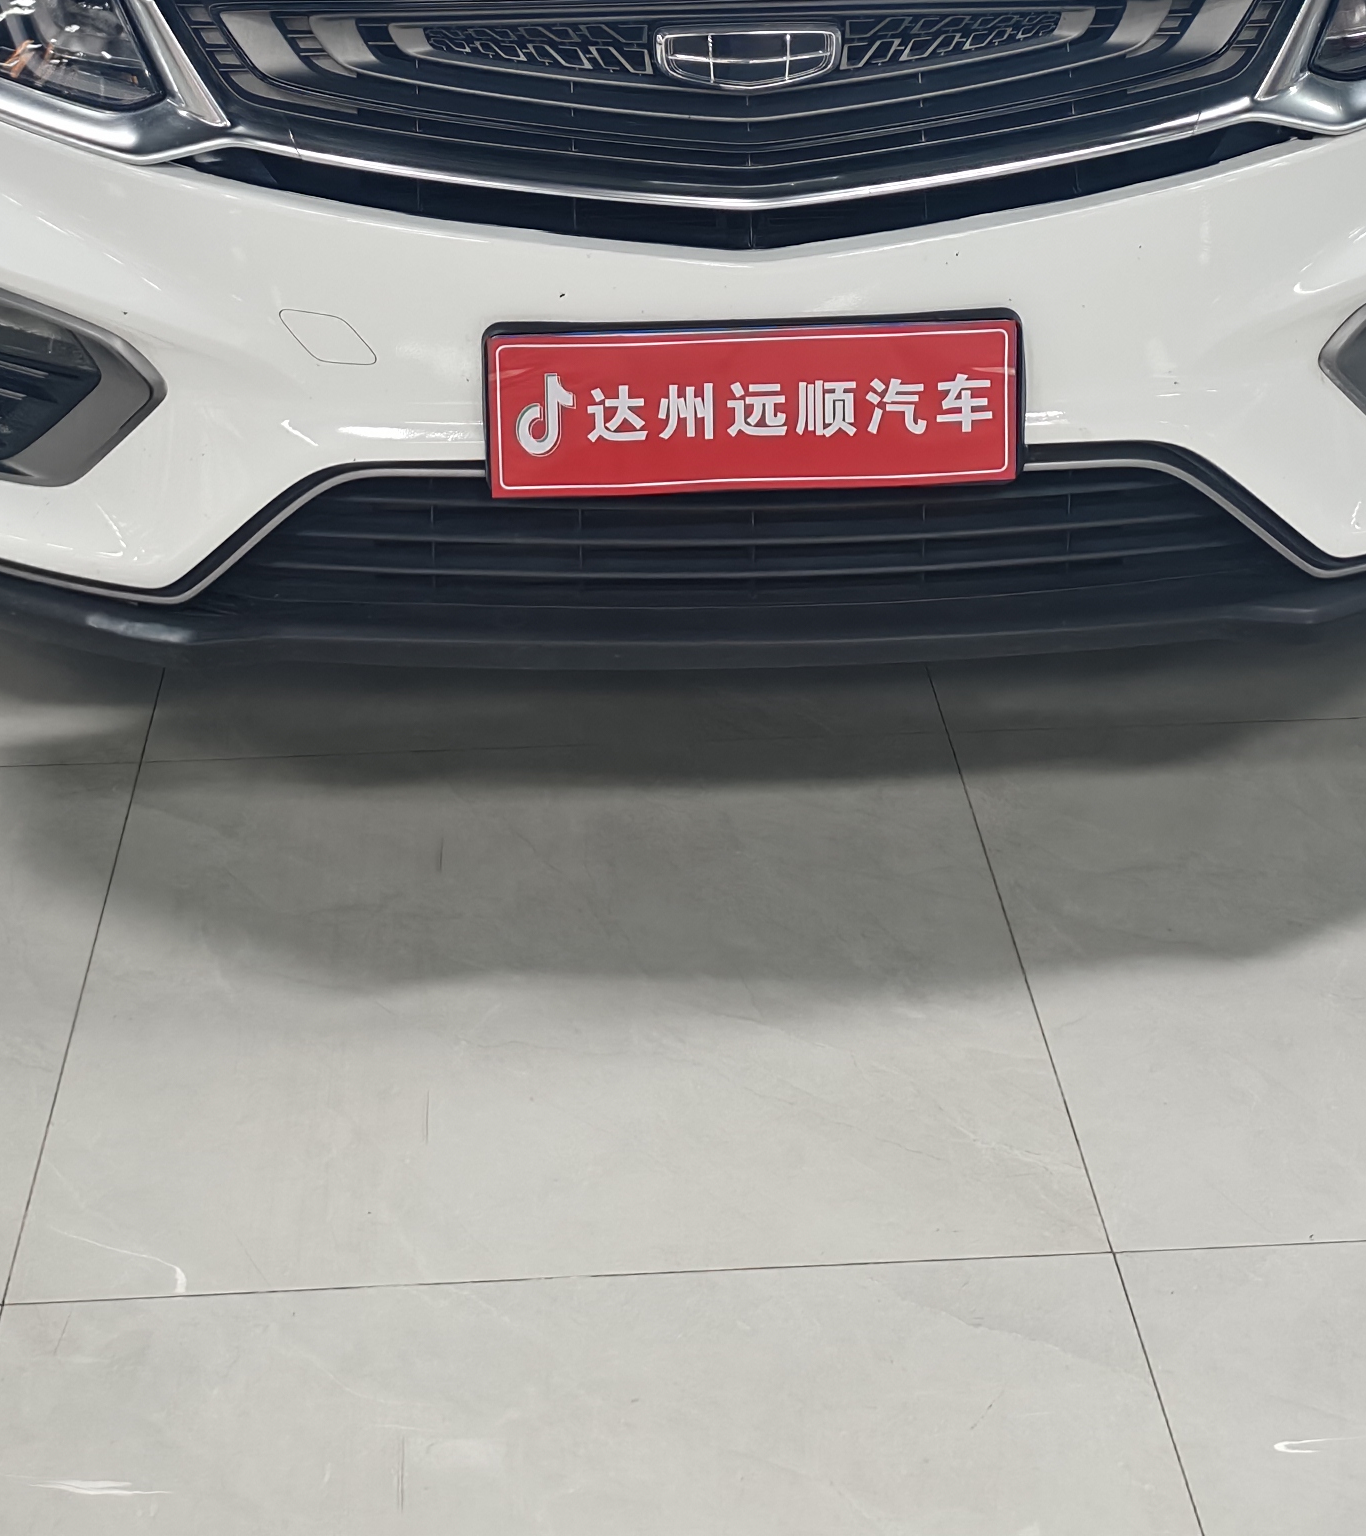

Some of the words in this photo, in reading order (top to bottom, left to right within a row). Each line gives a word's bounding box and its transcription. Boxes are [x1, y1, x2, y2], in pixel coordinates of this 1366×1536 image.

[586, 372, 994, 443] 达州远顺汽车
